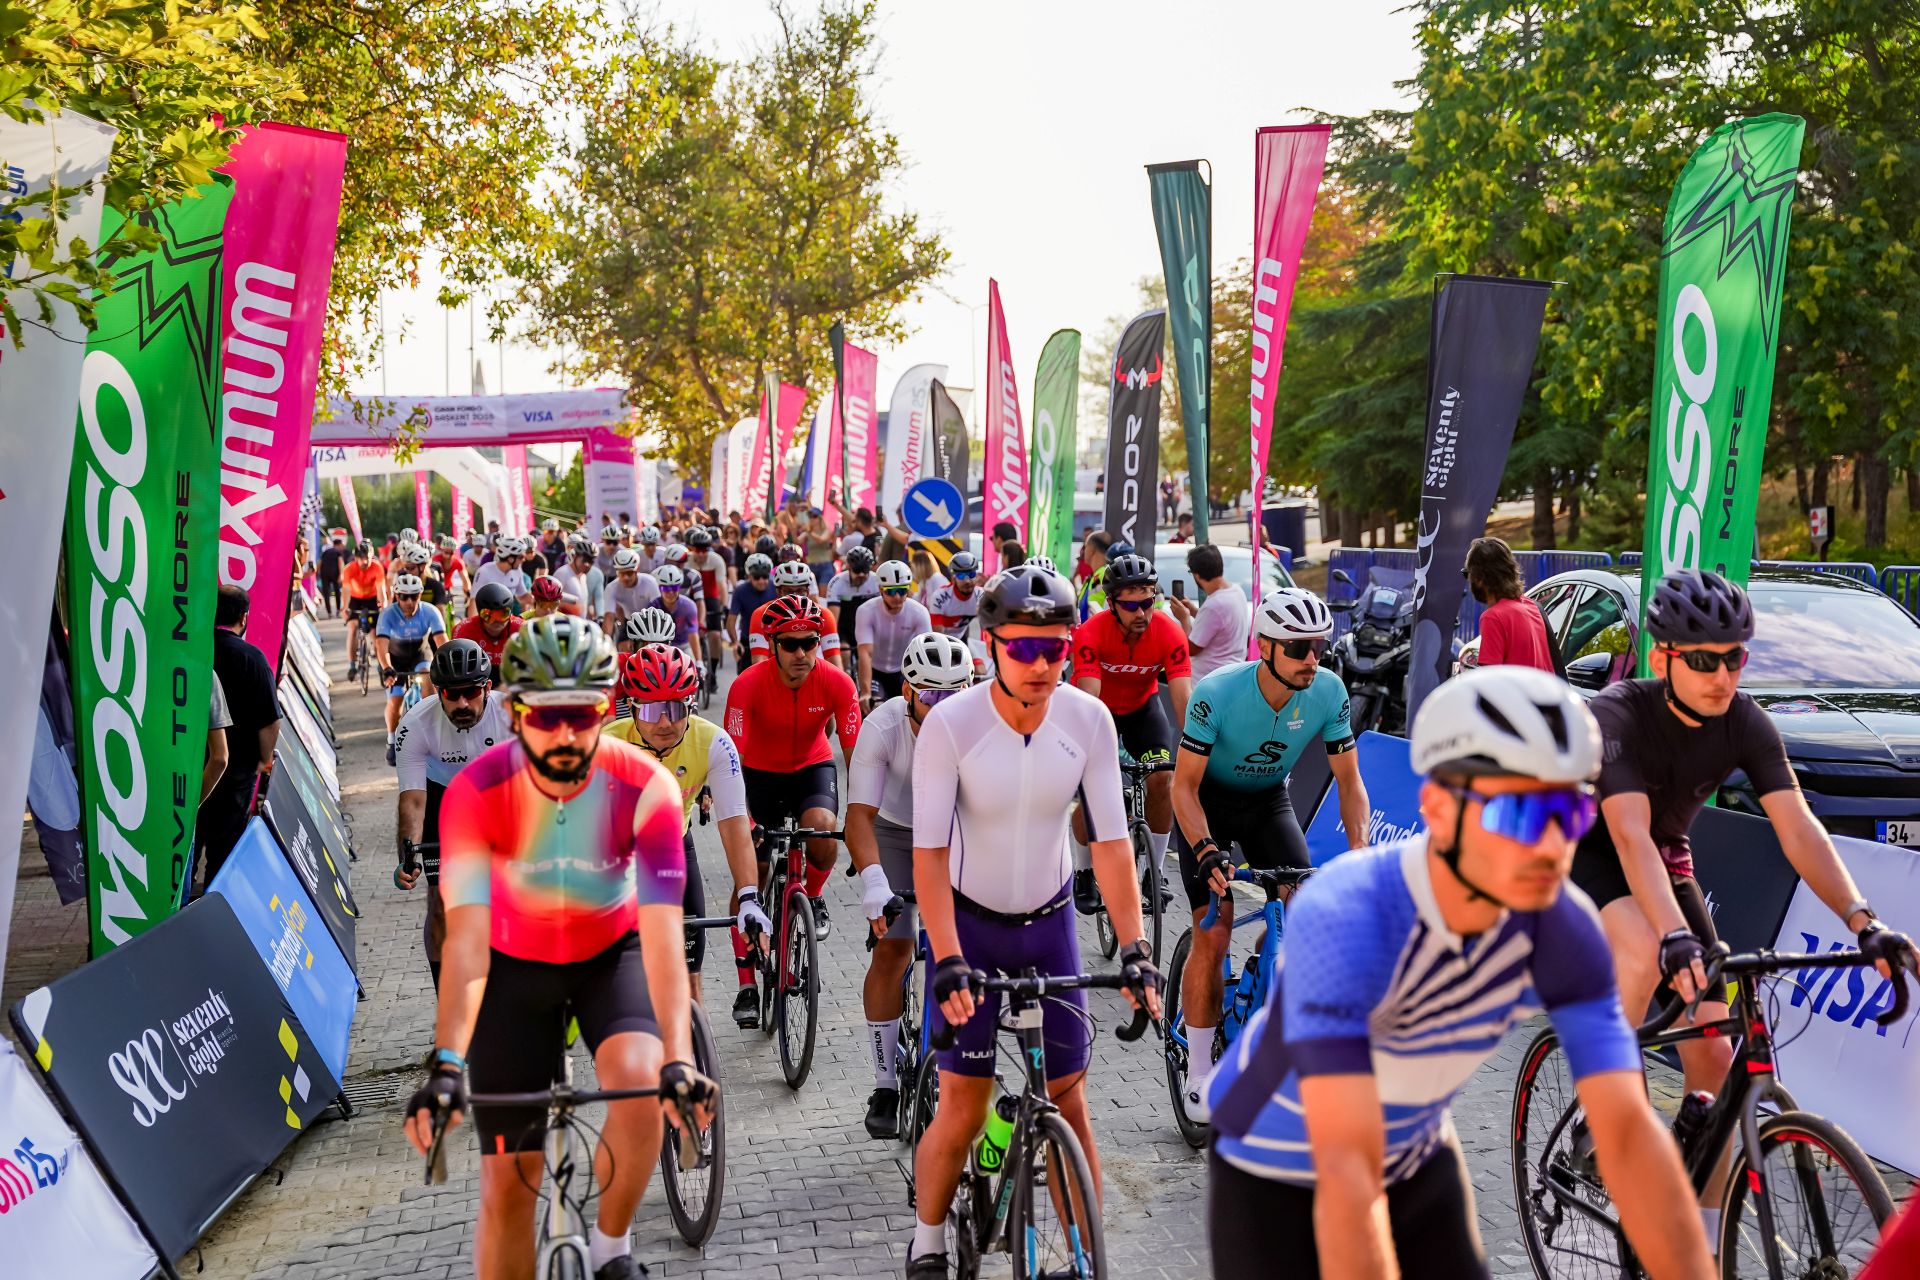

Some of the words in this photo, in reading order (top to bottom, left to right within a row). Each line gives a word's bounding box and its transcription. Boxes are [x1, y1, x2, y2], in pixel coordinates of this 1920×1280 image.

[219, 262, 296, 592] aximum
[524, 411, 554, 422] VISA
[1426, 386, 1460, 487] seventy
[1121, 414, 1142, 548] ADOR
[1438, 431, 1458, 489] eight
[1719, 386, 1745, 539] MORE
[172, 470, 192, 641] MORE
[80, 350, 148, 946] MOSSO
[1100, 661, 1161, 674] SCOTT
[172, 669, 188, 734] TO
[1233, 764, 1284, 775] MAMBA
[170, 772, 188, 904] OVE
[1887, 824, 1909, 843] 34
[172, 988, 234, 1046] seventy
[874, 1030, 885, 1063] DECATHLON
[188, 1031, 226, 1075] eight
